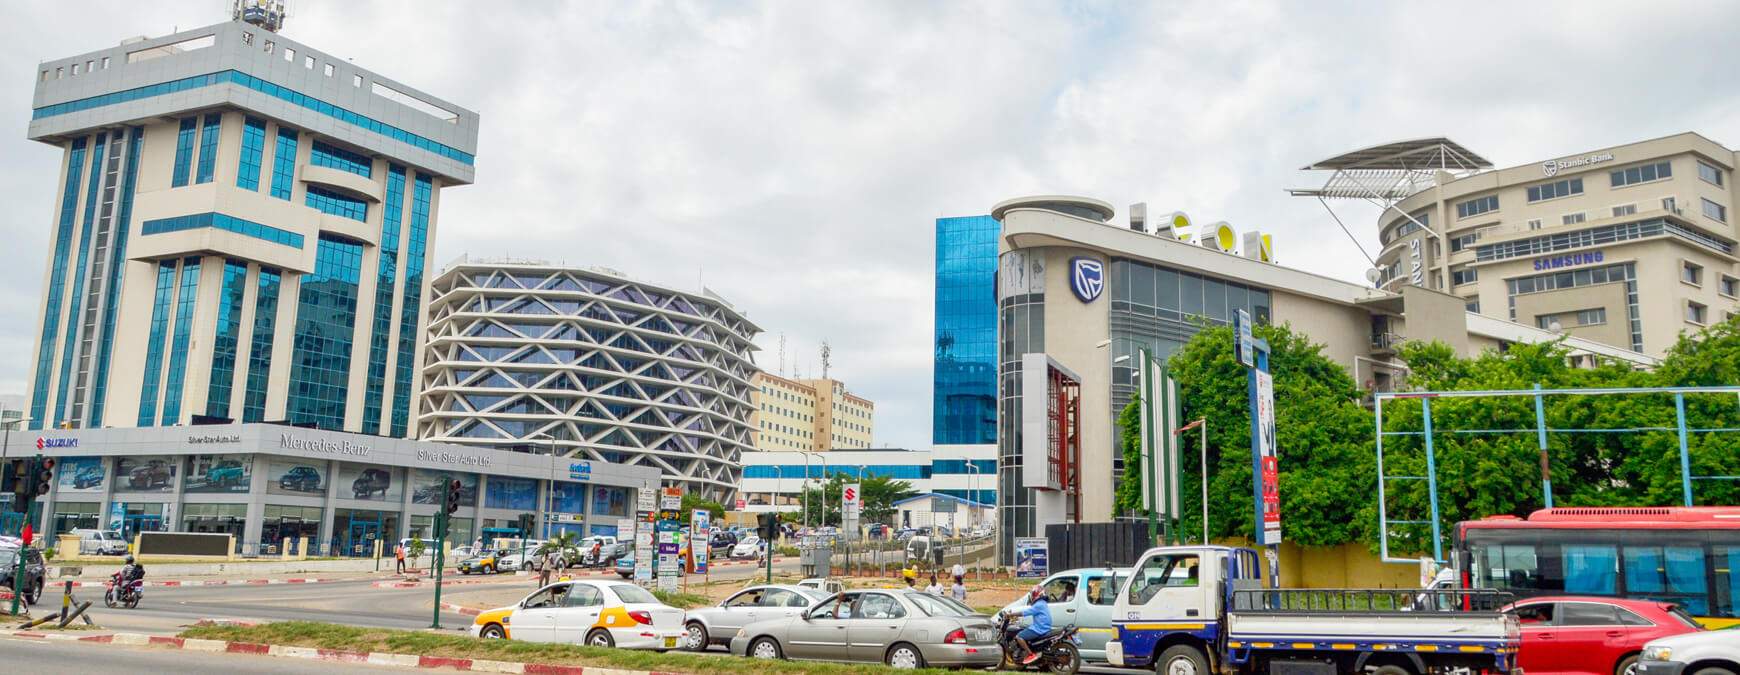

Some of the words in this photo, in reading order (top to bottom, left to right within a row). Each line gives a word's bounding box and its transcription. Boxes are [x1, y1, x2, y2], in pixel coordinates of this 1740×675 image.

[1560, 158, 1590, 169] Stanbic
[1591, 152, 1614, 163] Bank
[1129, 202, 1274, 264] ICON
[1534, 250, 1604, 271] SAMSUNG
[46, 438, 79, 448] SUZUKI
[280, 433, 371, 456] Mercedes-Benz
[418, 449, 440, 462] Silver
[442, 451, 459, 464] Star
[460, 453, 478, 466] Auto
